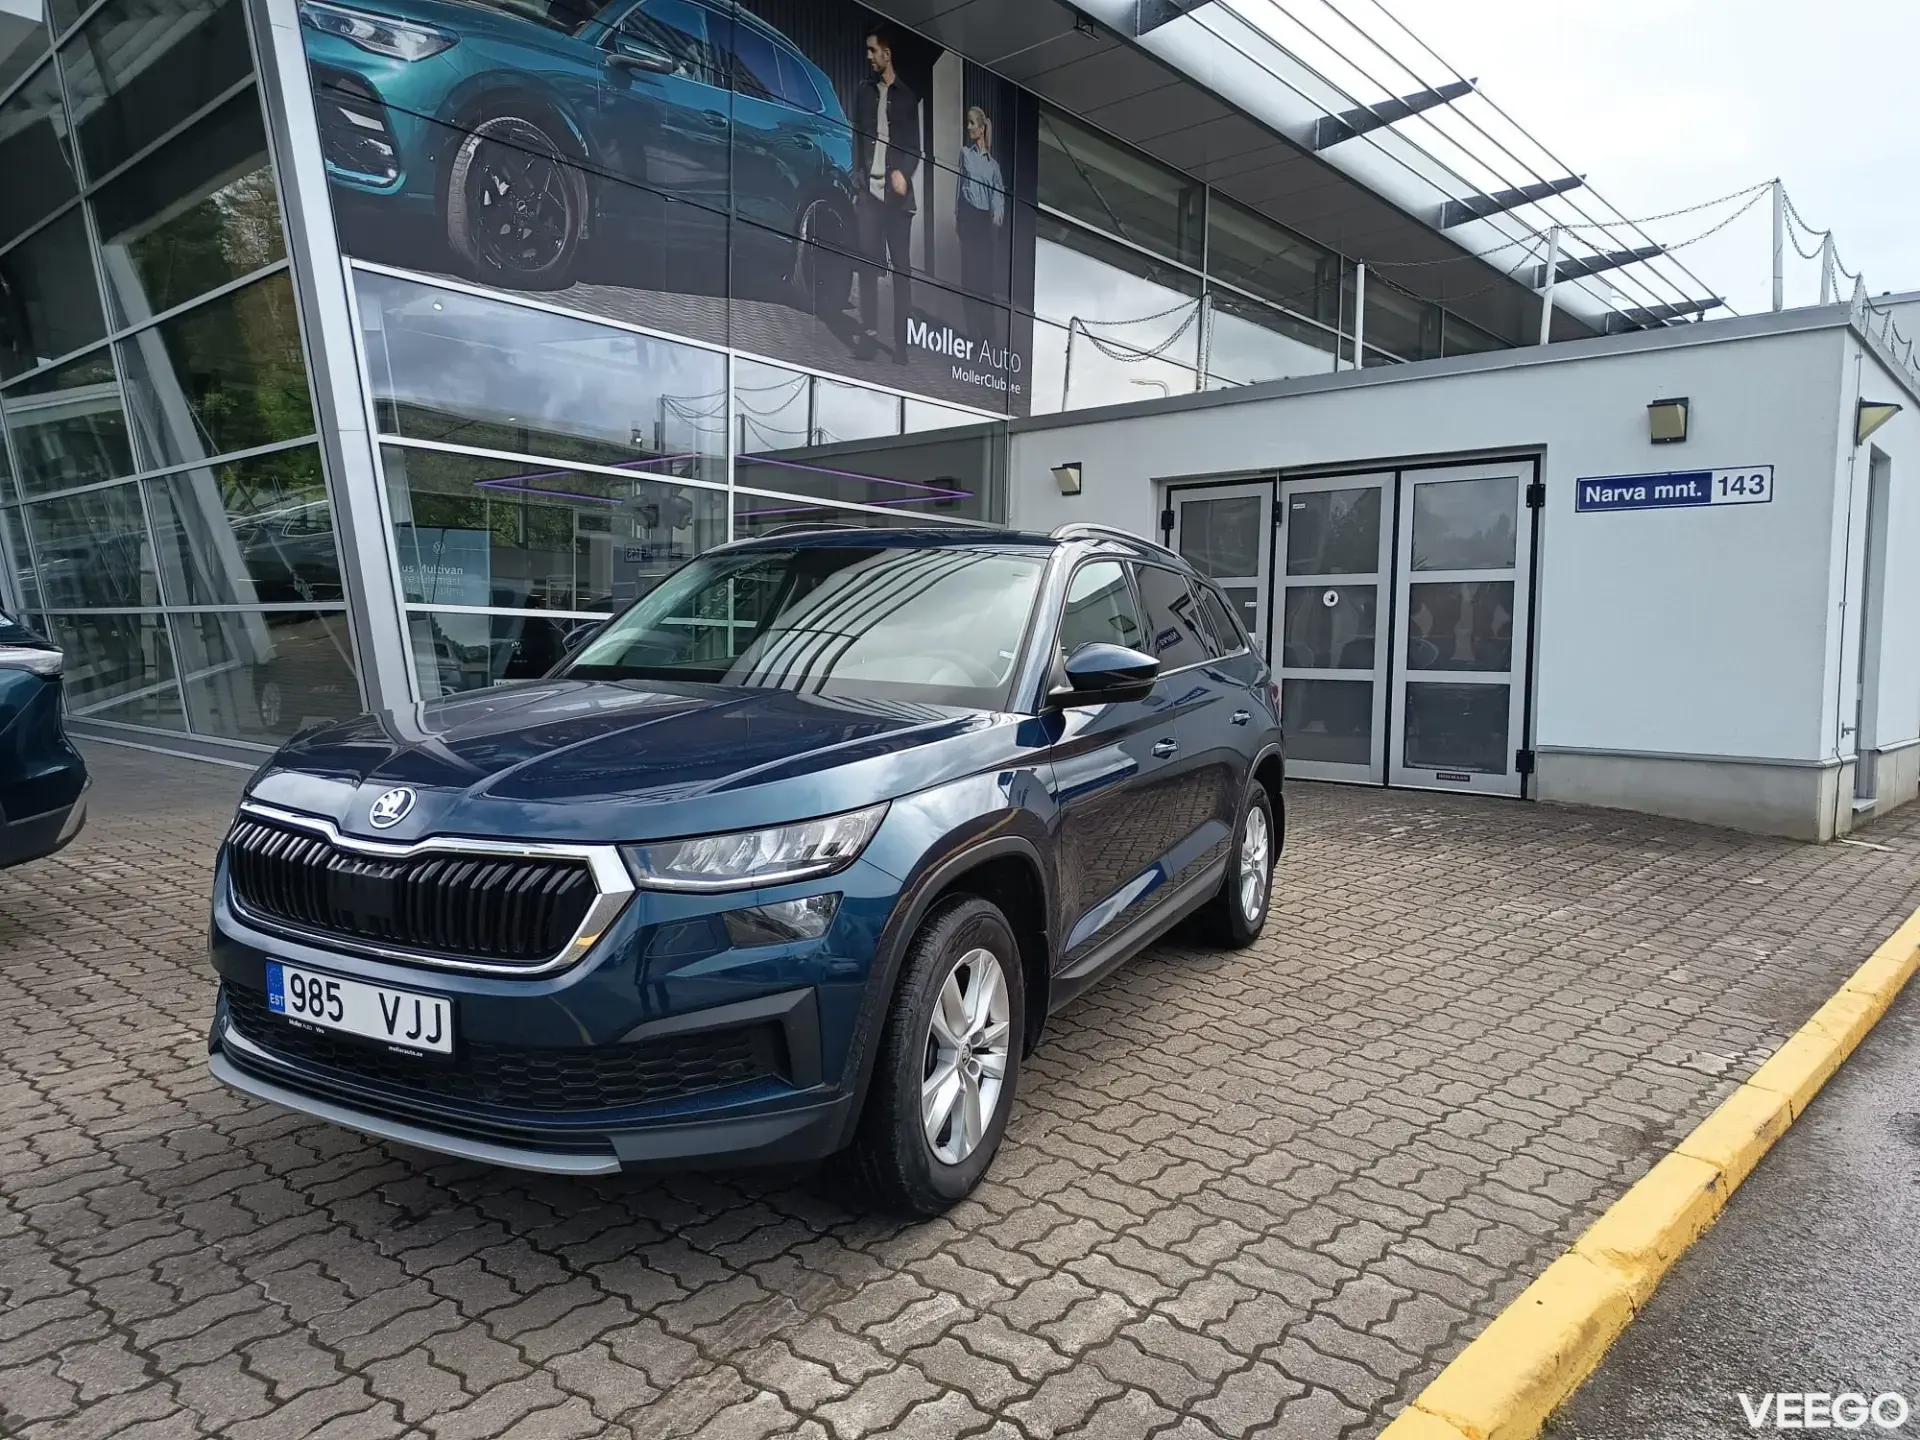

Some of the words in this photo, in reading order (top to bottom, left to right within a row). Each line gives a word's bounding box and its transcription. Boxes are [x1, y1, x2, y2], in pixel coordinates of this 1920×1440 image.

[978, 338, 1021, 373] Auto
[1585, 485, 1646, 503] Narva
[1653, 480, 1702, 499] mnt.
[1717, 473, 1765, 496] 143
[270, 993, 284, 1007] EST
[290, 973, 344, 1022] 985
[378, 992, 442, 1044] VJJ
